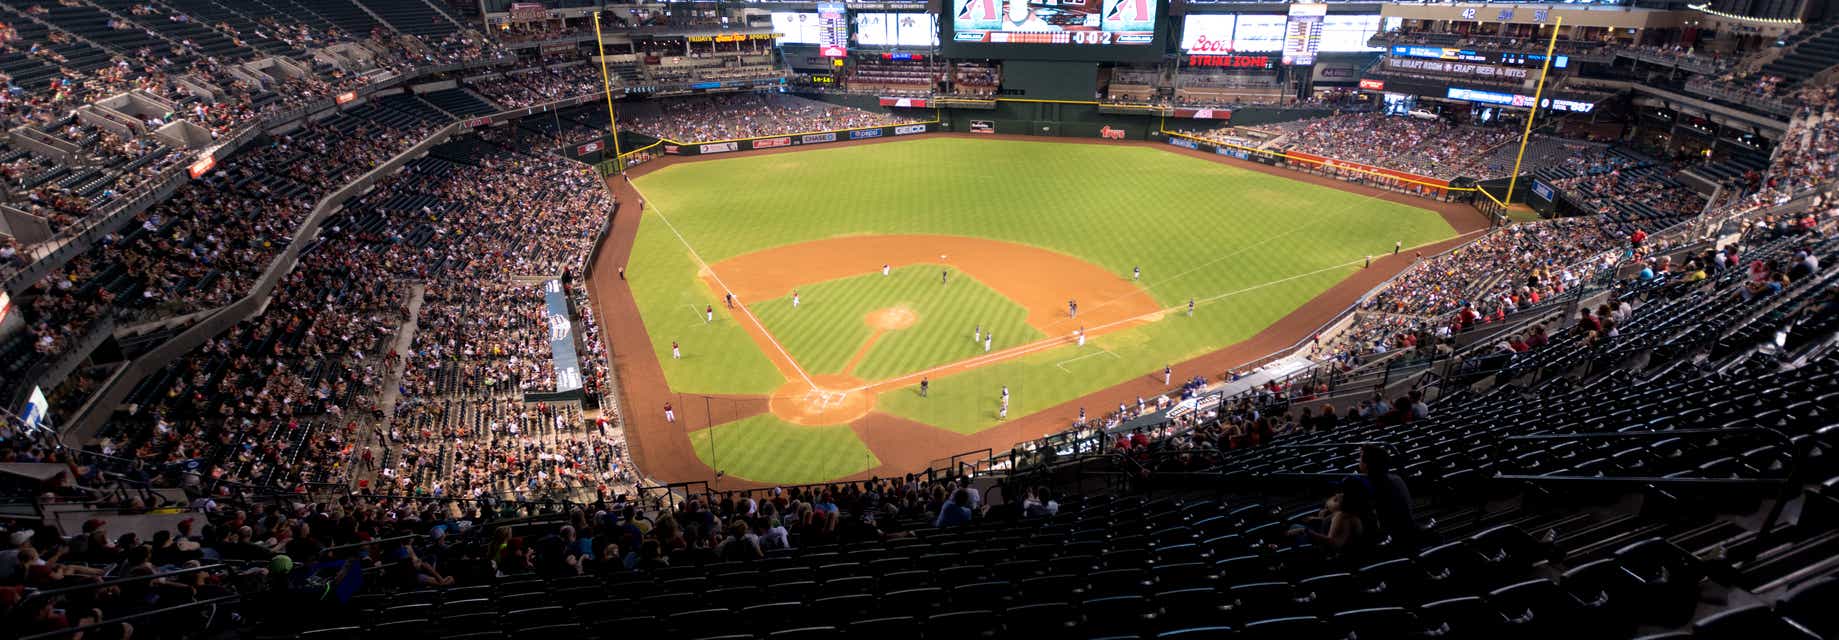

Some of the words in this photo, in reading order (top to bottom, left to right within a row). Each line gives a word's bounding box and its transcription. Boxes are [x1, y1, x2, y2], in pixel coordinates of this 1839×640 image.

[1462, 8, 1475, 19] 42
[1076, 31, 1084, 44] 0
[1089, 31, 1097, 44] 0
[1102, 31, 1111, 44] 2
[1190, 55, 1231, 66] STRIKE
[1233, 55, 1268, 67] ZONE
[1391, 58, 1401, 67] THE
[1402, 59, 1423, 69] DRAFT
[1453, 64, 1475, 73] CRAFT
[1476, 66, 1495, 75] BEER
[1504, 68, 1526, 78] BITES
[1541, 98, 1550, 108] 0
[805, 133, 828, 142] CHASE
